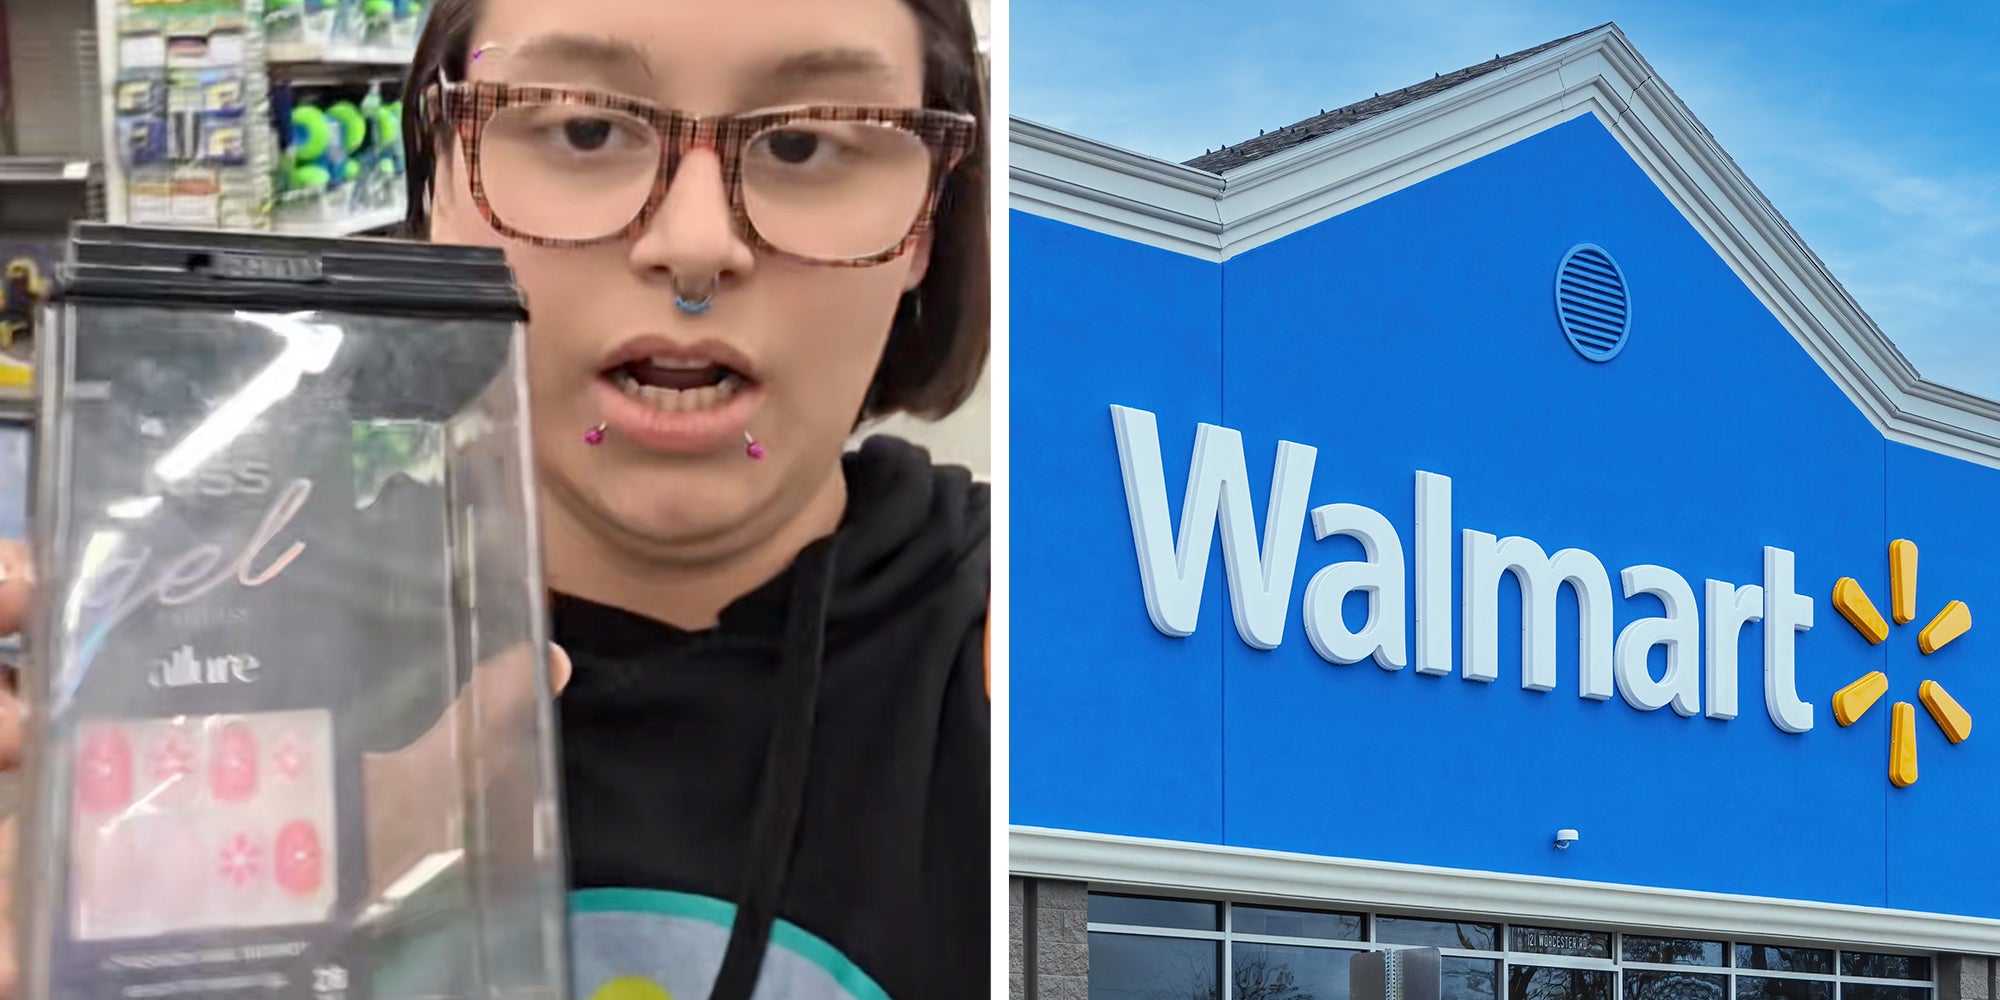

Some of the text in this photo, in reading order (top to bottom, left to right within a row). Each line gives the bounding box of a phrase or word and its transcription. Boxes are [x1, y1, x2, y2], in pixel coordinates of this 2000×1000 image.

[78, 477, 313, 640] gel
[1110, 404, 1815, 734] Walmart
[147, 644, 261, 687] allure
[1527, 933, 1537, 946] 121
[1539, 934, 1577, 949] WORCESTER
